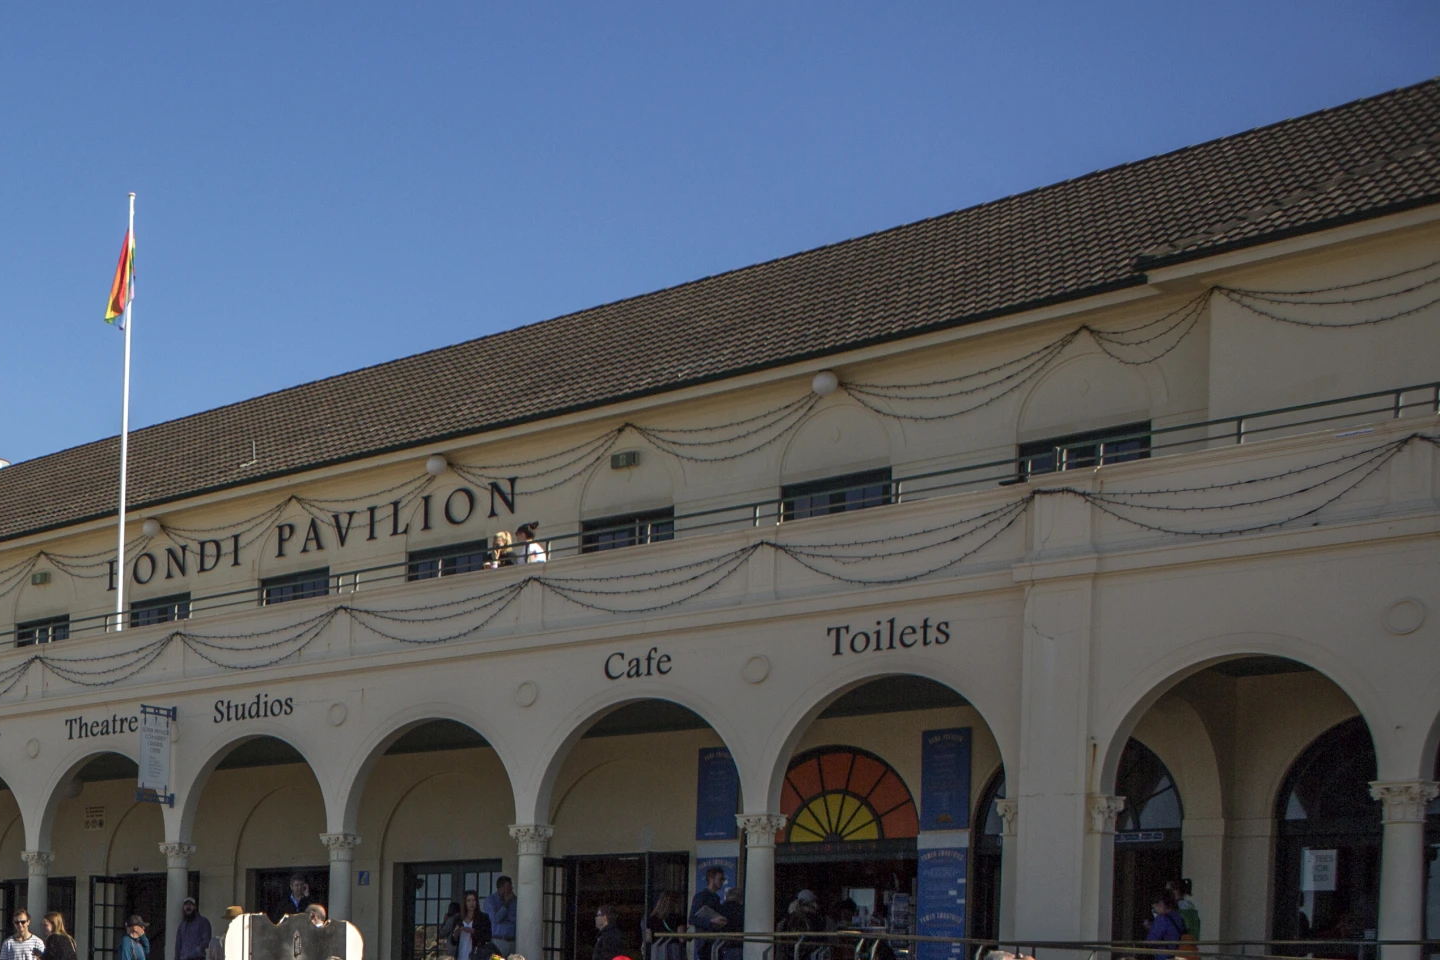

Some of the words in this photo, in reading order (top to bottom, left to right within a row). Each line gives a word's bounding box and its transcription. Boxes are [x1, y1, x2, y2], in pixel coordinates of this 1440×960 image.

[275, 476, 519, 558] PAVILION
[826, 617, 951, 656] Toilets
[604, 647, 673, 680] Cafe
[213, 693, 294, 724] Studios
[65, 713, 139, 740] Theatre
